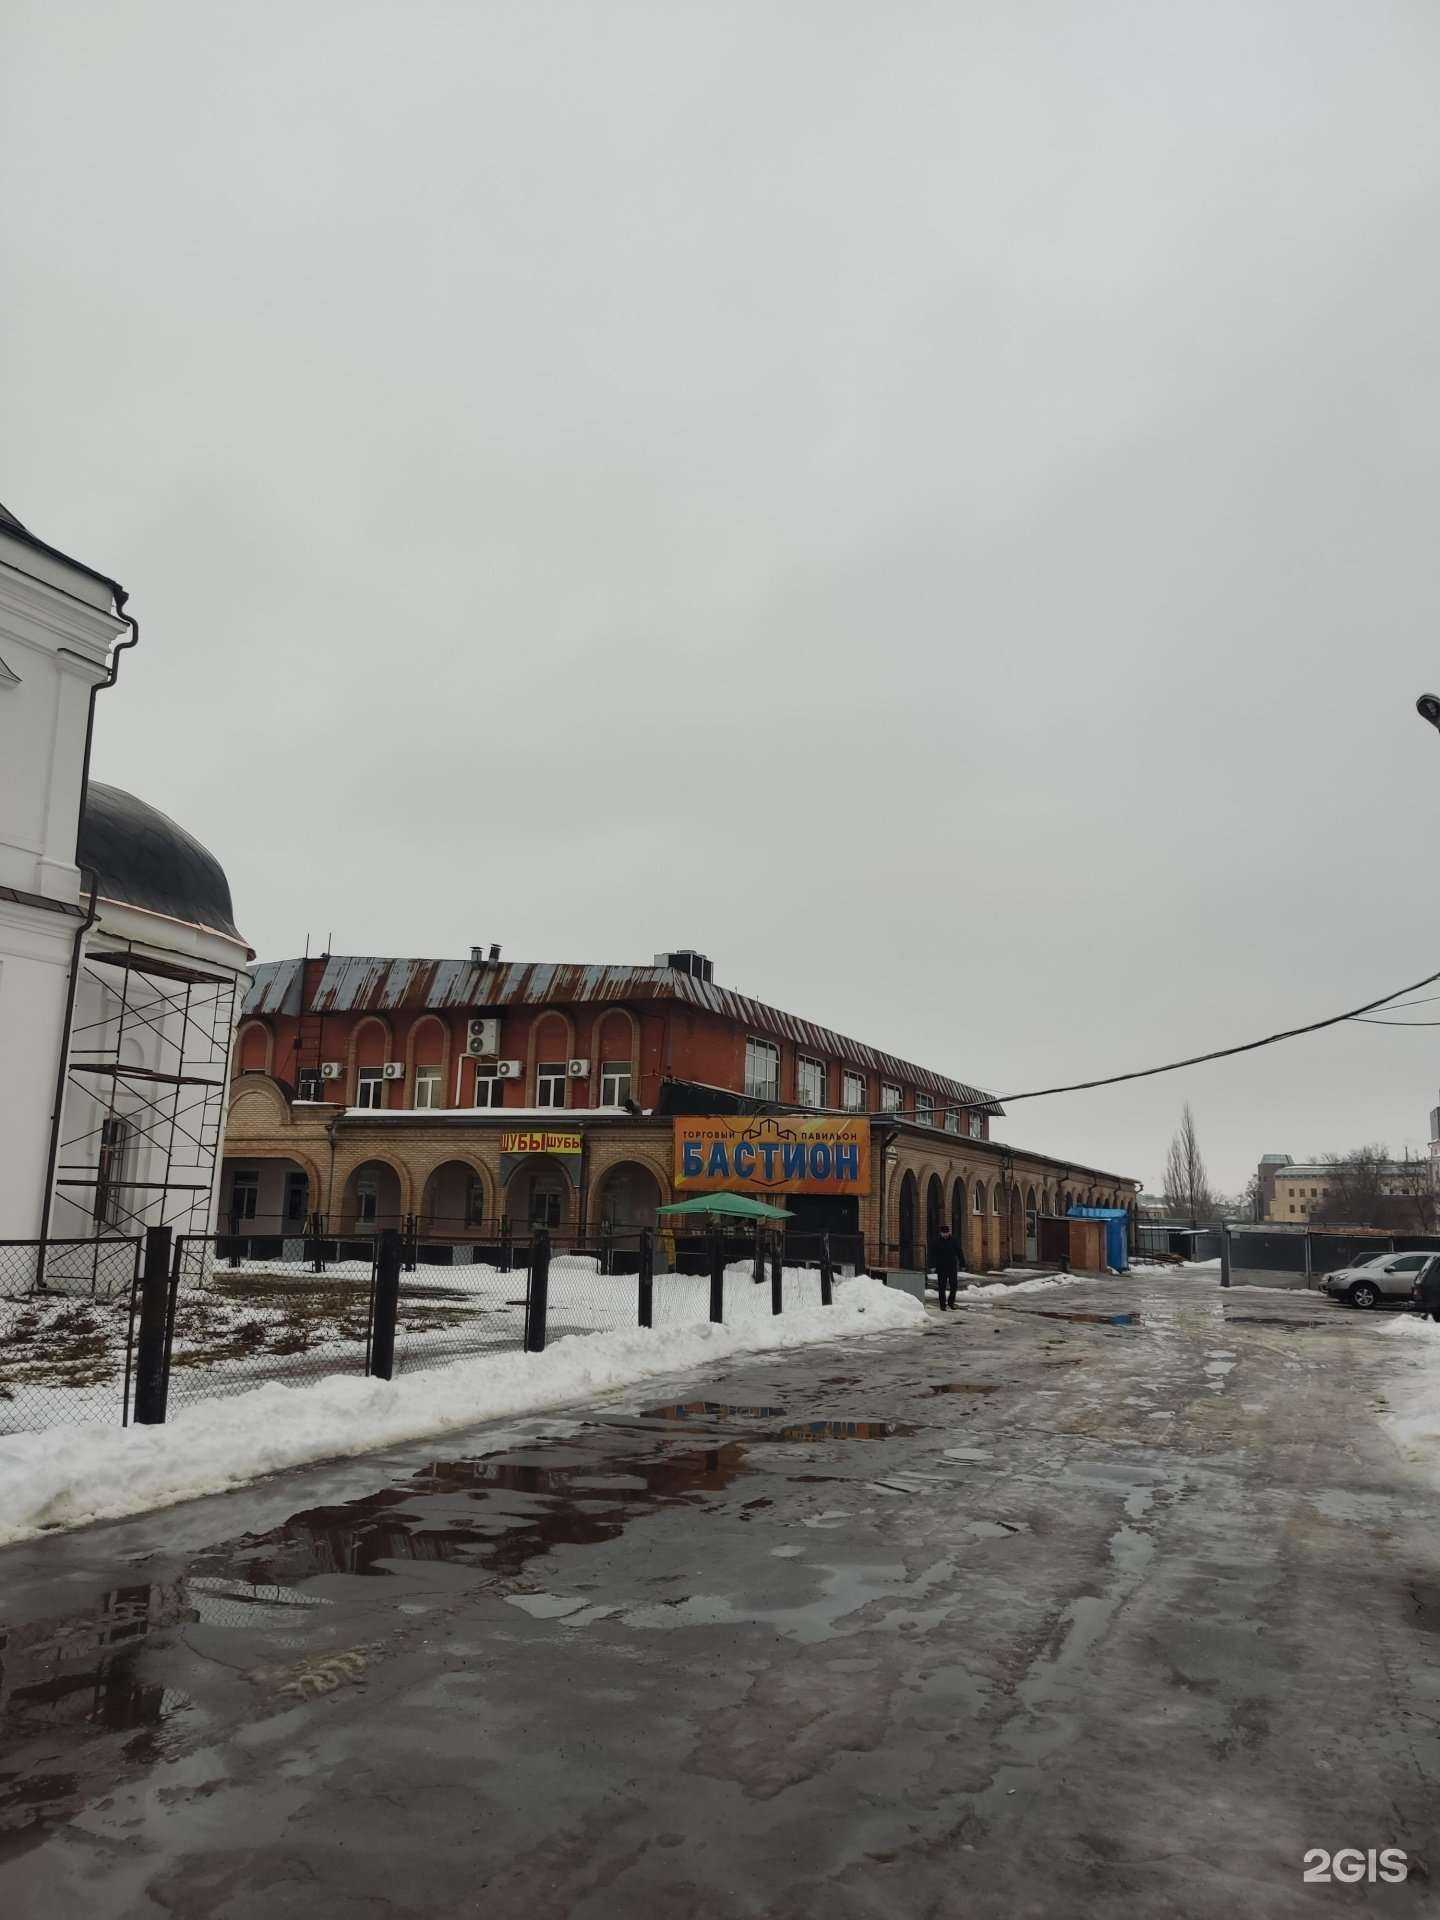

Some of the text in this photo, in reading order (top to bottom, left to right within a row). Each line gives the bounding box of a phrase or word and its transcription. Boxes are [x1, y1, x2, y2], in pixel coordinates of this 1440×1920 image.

[683, 1130, 857, 1141] ТОРГОВЫЙ ПАВИЛЬОН
[683, 1141, 860, 1181] БАСТИОН
